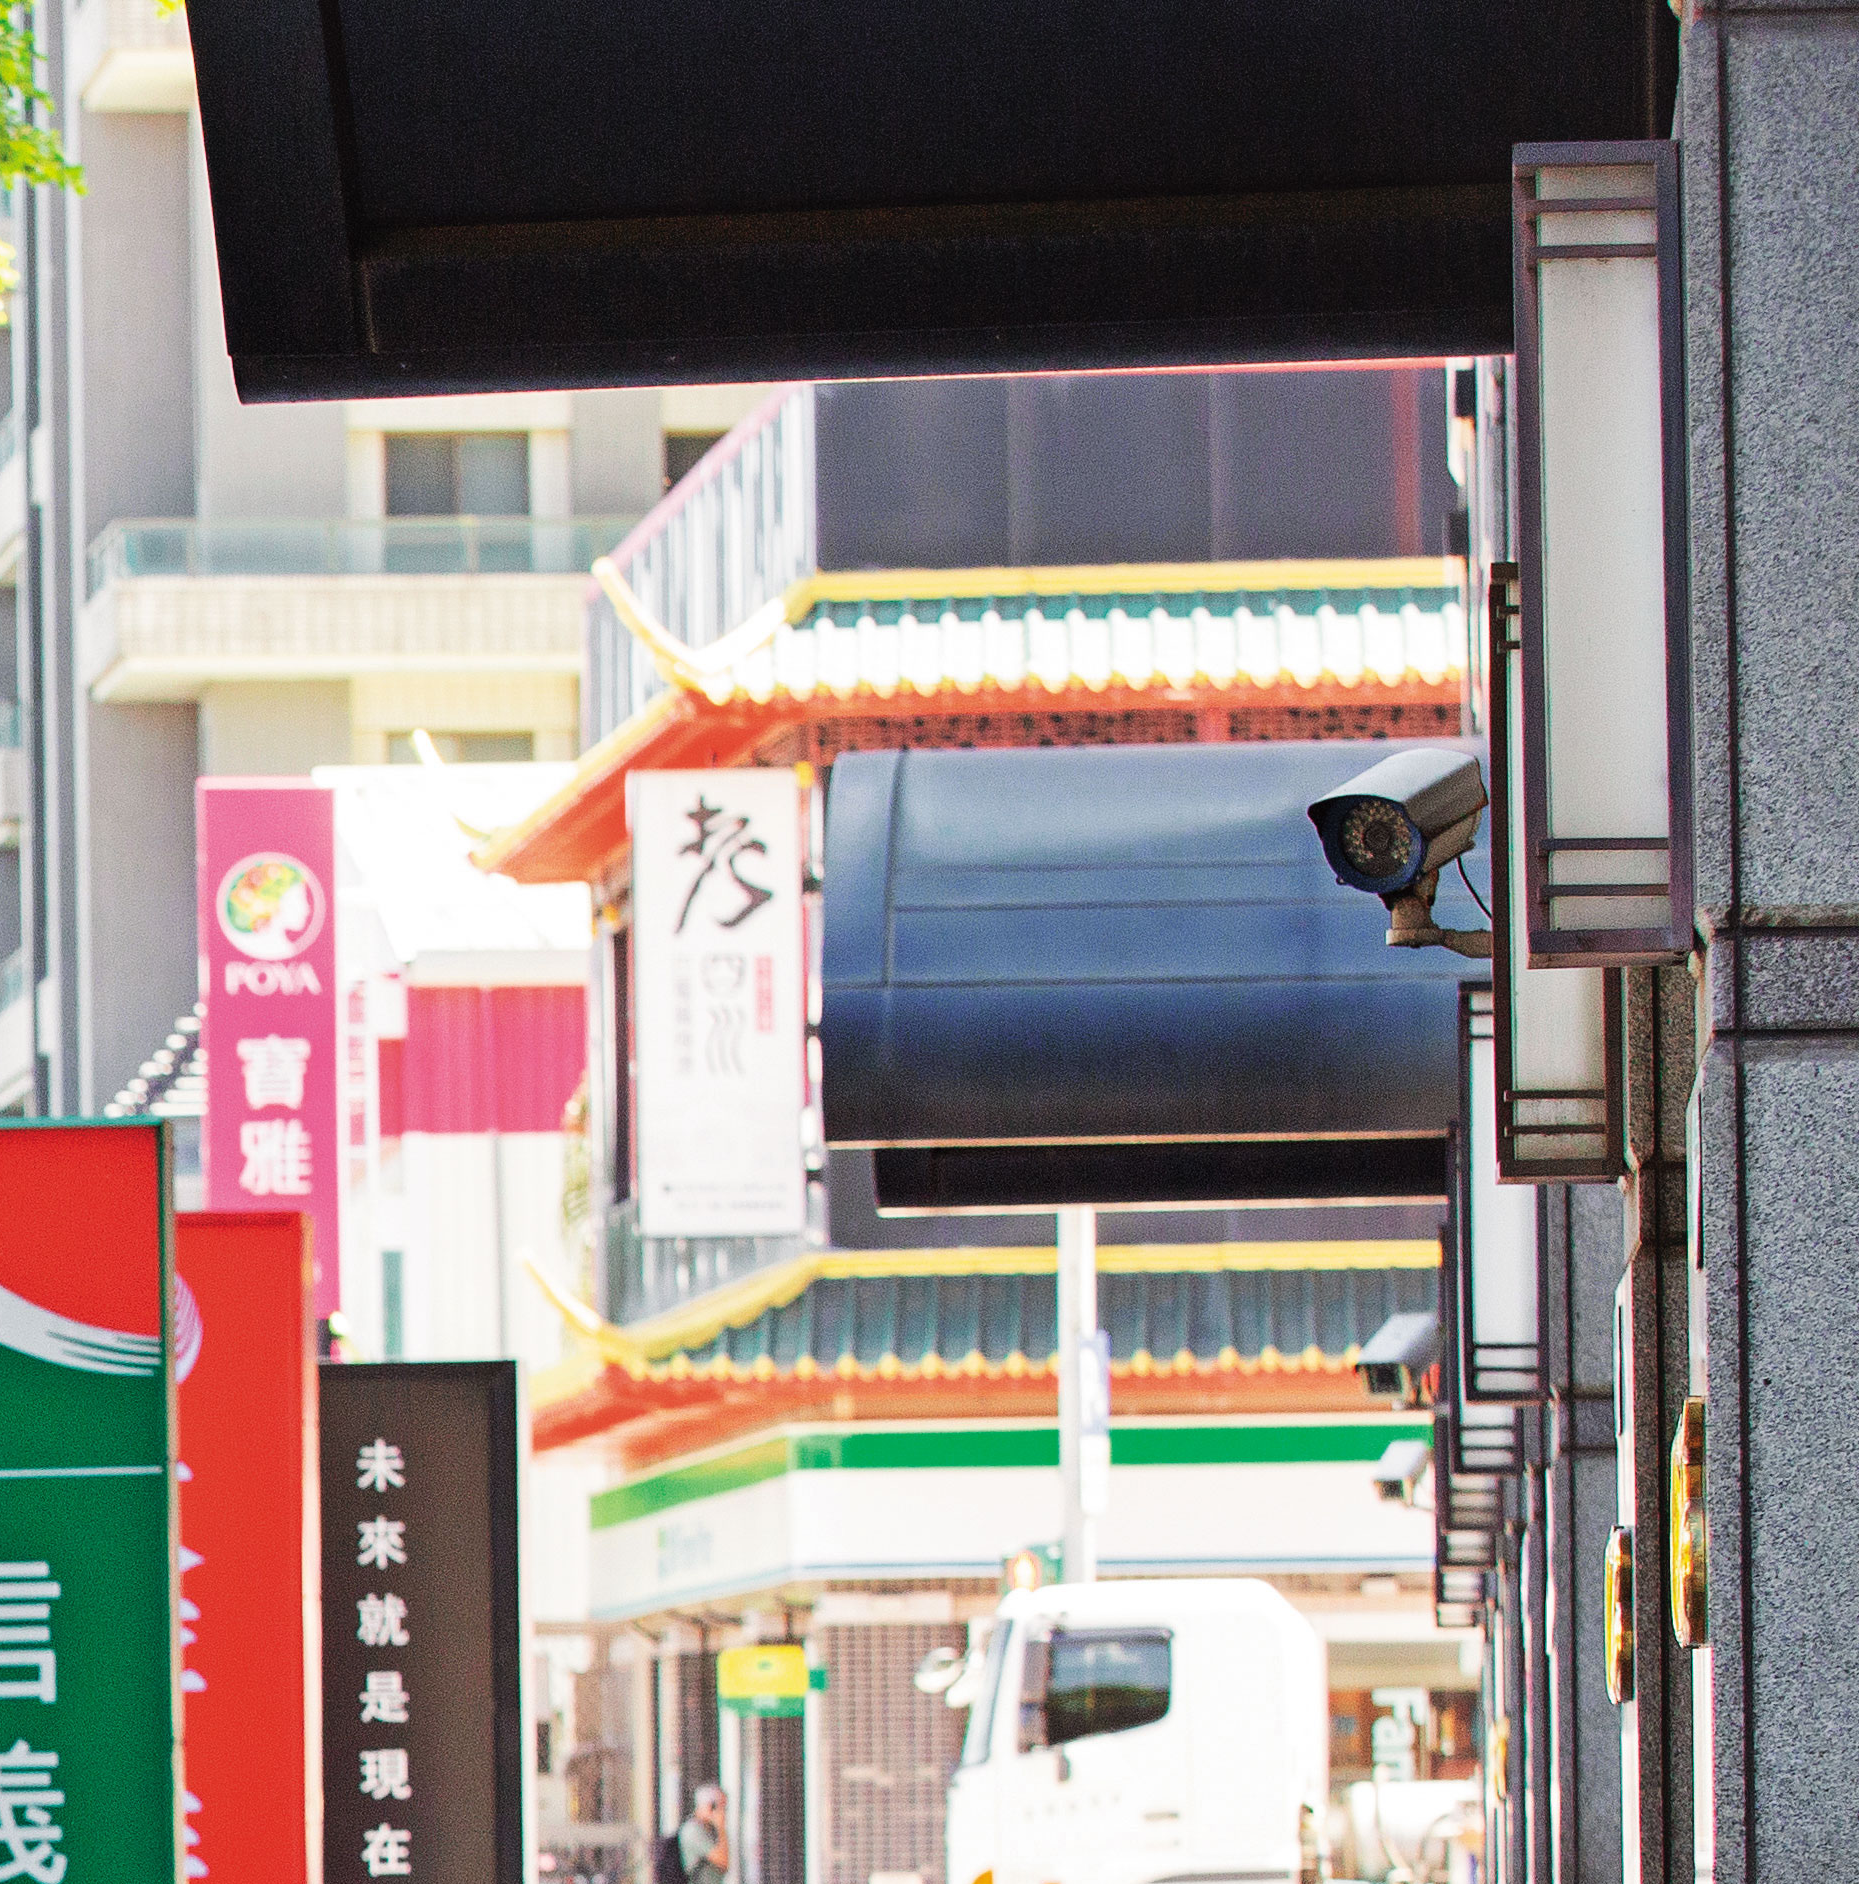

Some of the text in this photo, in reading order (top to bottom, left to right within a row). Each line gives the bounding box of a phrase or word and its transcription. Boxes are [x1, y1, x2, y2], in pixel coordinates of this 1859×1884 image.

[356, 1437, 412, 1878] 未來就是現在
